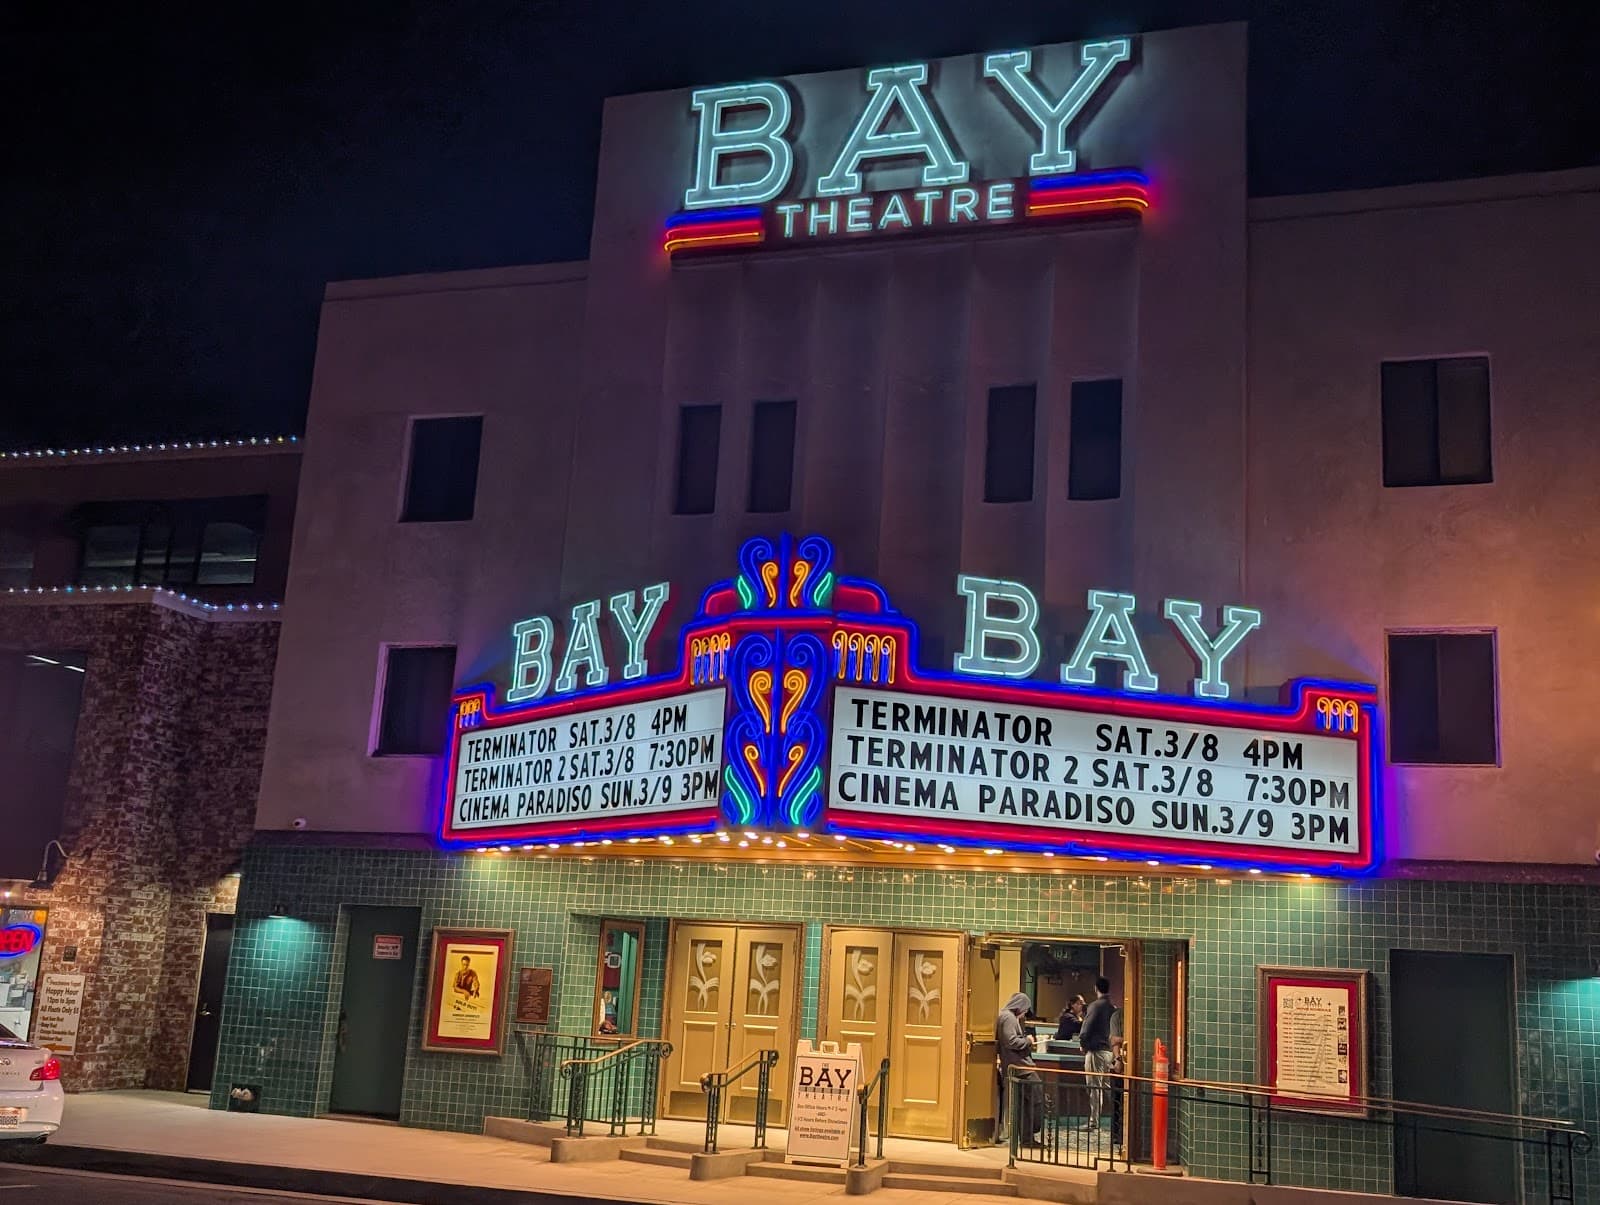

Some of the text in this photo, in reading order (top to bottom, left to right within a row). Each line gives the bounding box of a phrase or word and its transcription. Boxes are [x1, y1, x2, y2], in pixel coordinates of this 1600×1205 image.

[684, 39, 1132, 210] BAY
[775, 183, 1016, 239] THEATRE
[507, 581, 670, 703] BAY
[953, 574, 1261, 698] BAY
[464, 759, 551, 793] TERMINATOR
[557, 756, 565, 781] 2
[650, 734, 715, 770] 7:30PM
[467, 704, 688, 764] TERMINATOR SAT.3/8 4PM
[851, 698, 1303, 770] TERMINATOR SAT.3/8 4PM
[459, 769, 719, 822] CINEMA PARADISO SUN.3/9 3PM
[847, 734, 1350, 810] TERMINATOR 2 SAT.3/8 7:30PM
[838, 771, 1350, 844] CINEMA PARADISO SUN.3/9 3PM
[45, 987, 79, 996] Happy Hour
[799, 1066, 852, 1088] BAY
